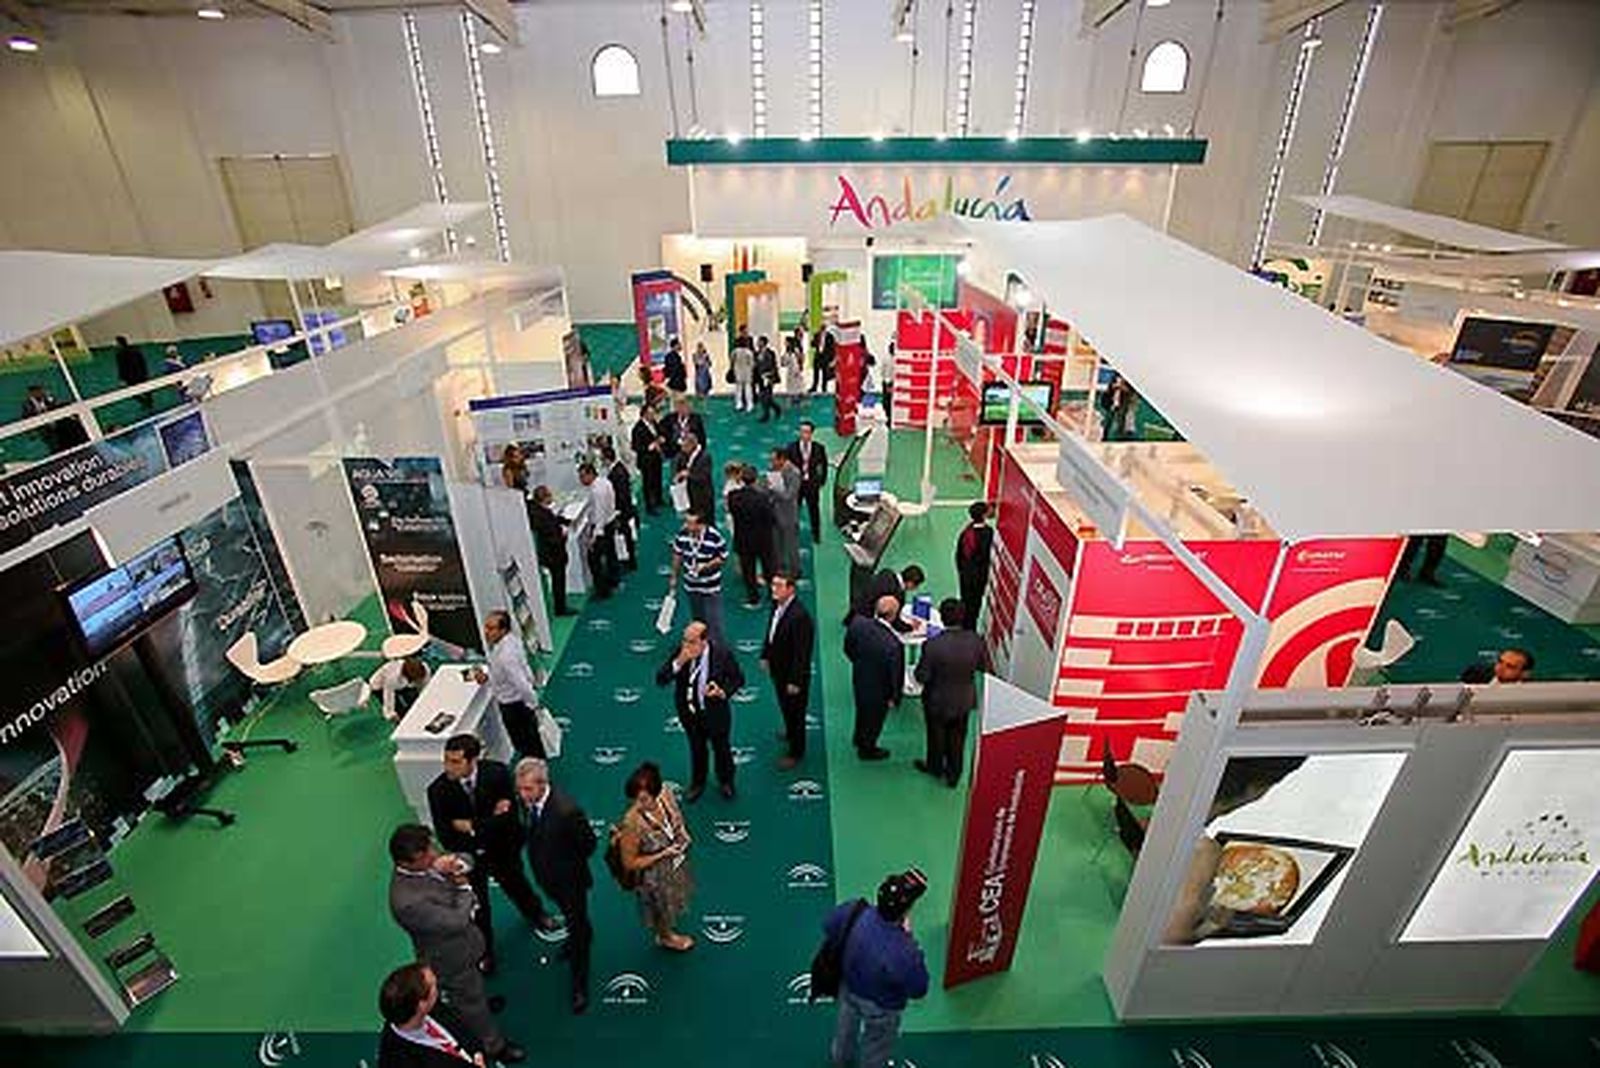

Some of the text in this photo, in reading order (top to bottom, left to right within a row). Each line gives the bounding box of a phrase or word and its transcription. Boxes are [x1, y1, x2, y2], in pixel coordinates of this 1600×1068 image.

[829, 175, 1031, 228] Andalucía
[8, 453, 103, 502] innovation
[979, 872, 1005, 914] CEA
